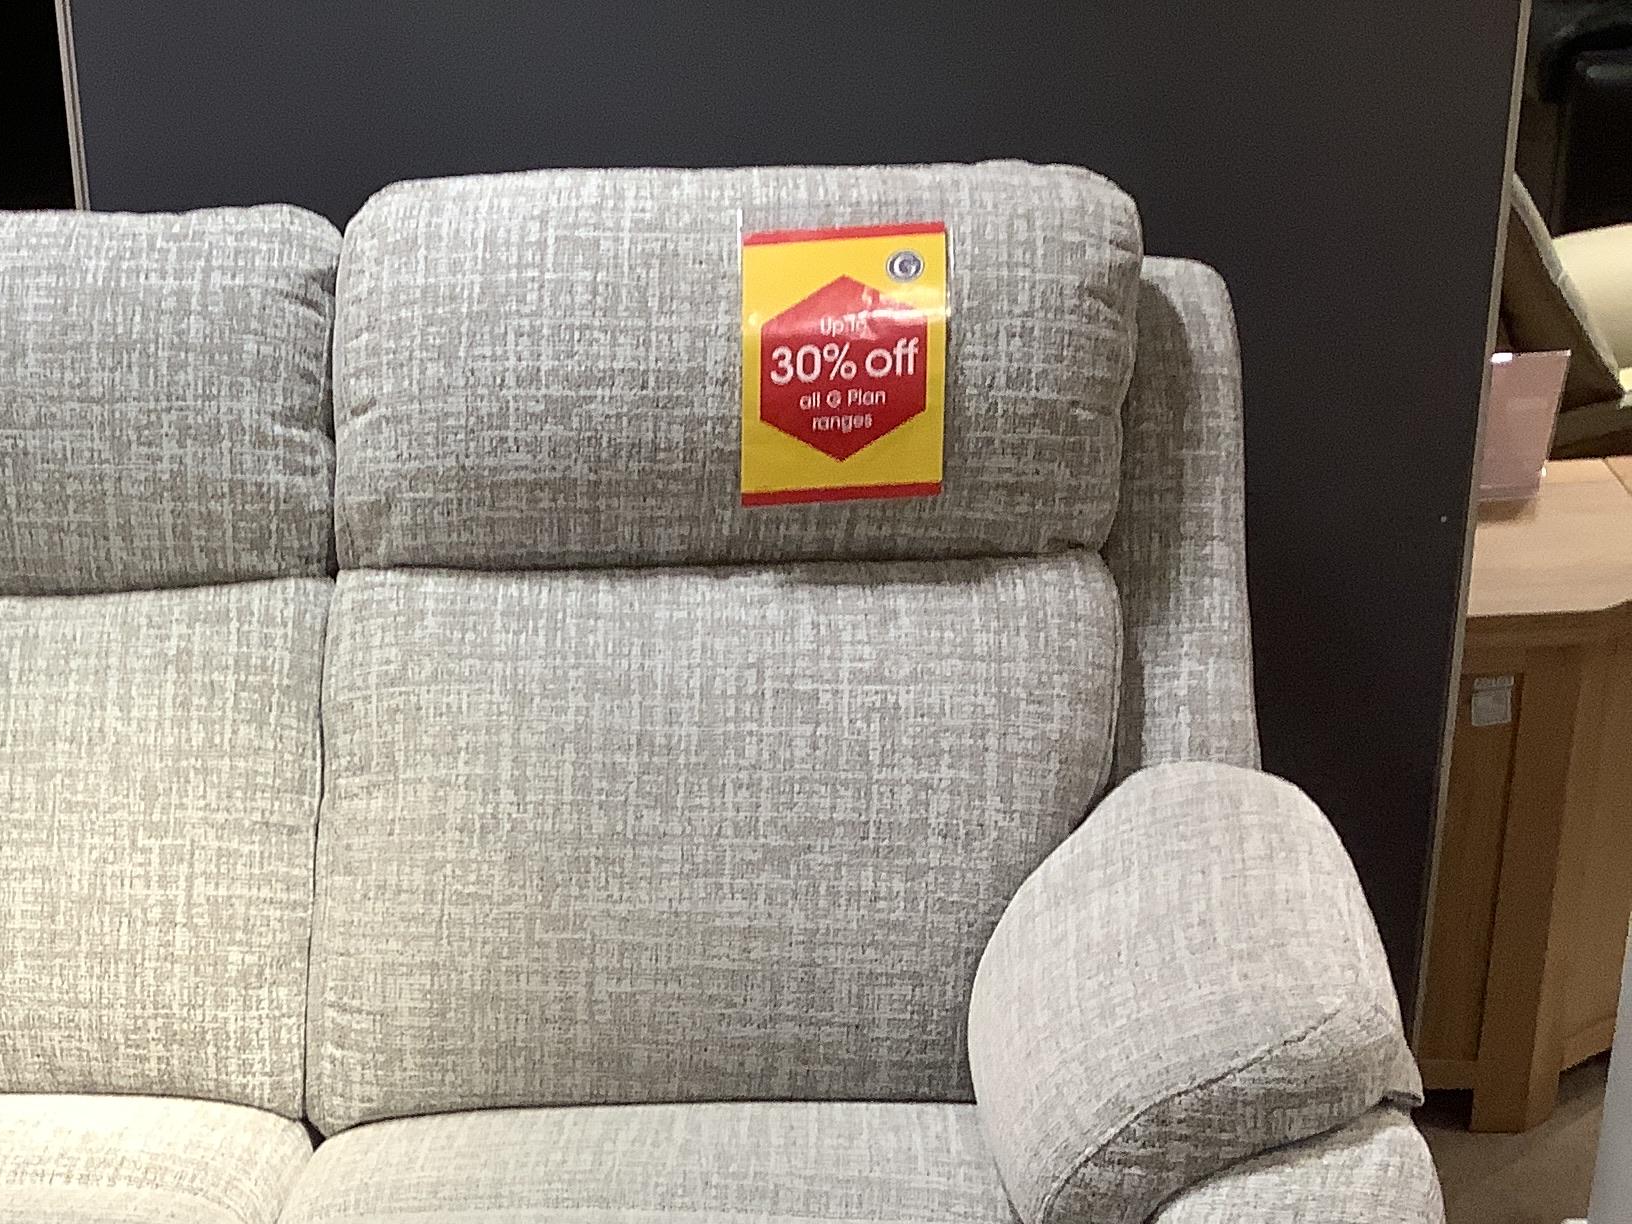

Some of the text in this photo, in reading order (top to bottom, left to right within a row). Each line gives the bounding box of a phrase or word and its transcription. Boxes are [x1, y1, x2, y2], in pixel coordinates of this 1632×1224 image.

[820, 316, 844, 338] Up
[770, 337, 920, 385] 30% off
[799, 391, 821, 410] all
[848, 388, 887, 407] Plan
[812, 414, 873, 433] ranges
